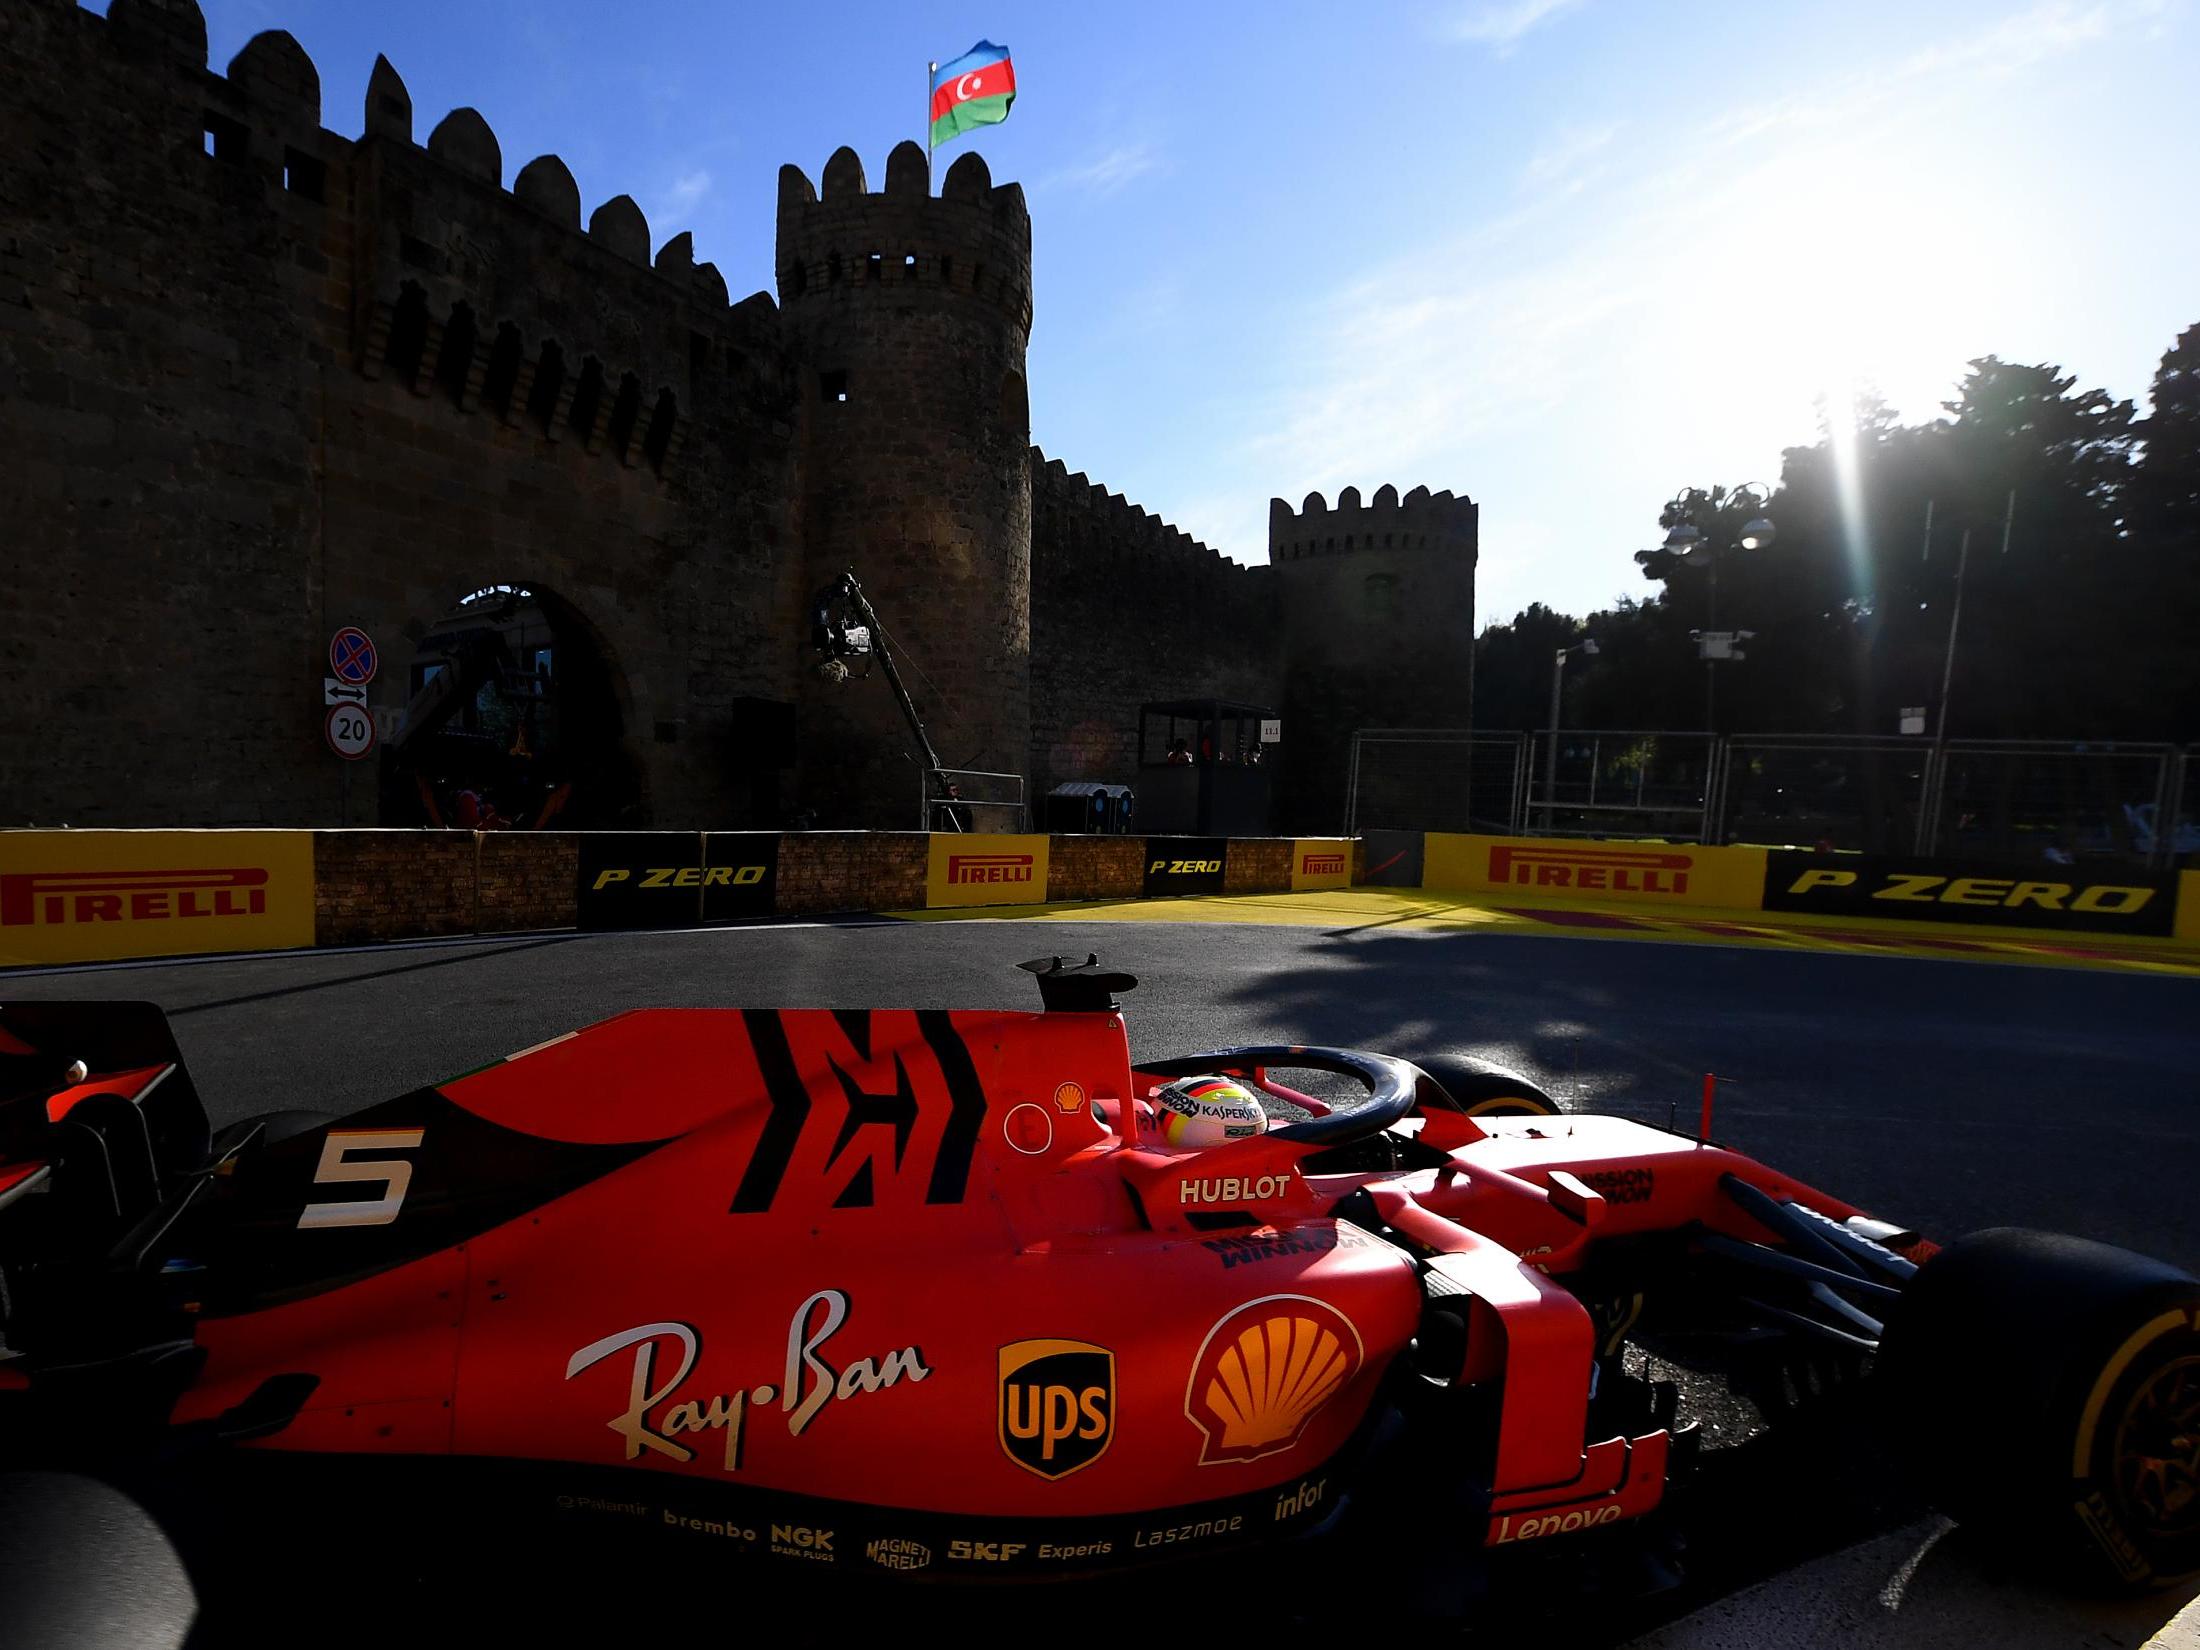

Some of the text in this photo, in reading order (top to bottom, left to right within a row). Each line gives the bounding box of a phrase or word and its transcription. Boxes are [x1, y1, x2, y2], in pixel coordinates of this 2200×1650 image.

[338, 718, 365, 741] 20
[592, 866, 767, 890] P ZERO
[948, 855, 1034, 884] PIRELLI
[1150, 860, 1222, 874] P ZERO
[1303, 855, 1345, 874] PIRELLI
[1489, 846, 1692, 894] PIRELLI
[1, 868, 269, 926] PIRELLI
[1787, 869, 2157, 914] P ZERO
[297, 1129, 426, 1229] 5
[1181, 1175, 1290, 1203] HUBLOT
[1582, 1167, 1654, 1188] ISSION
[1007, 1384, 1107, 1460] ups
[1274, 1478, 1327, 1521] infor
[663, 1508, 757, 1541] brembo
[771, 1524, 834, 1551] NGK
[1496, 1505, 1621, 1544] Lenovo
[947, 1540, 1027, 1561] SKF
[1038, 1540, 1113, 1560] Experis
